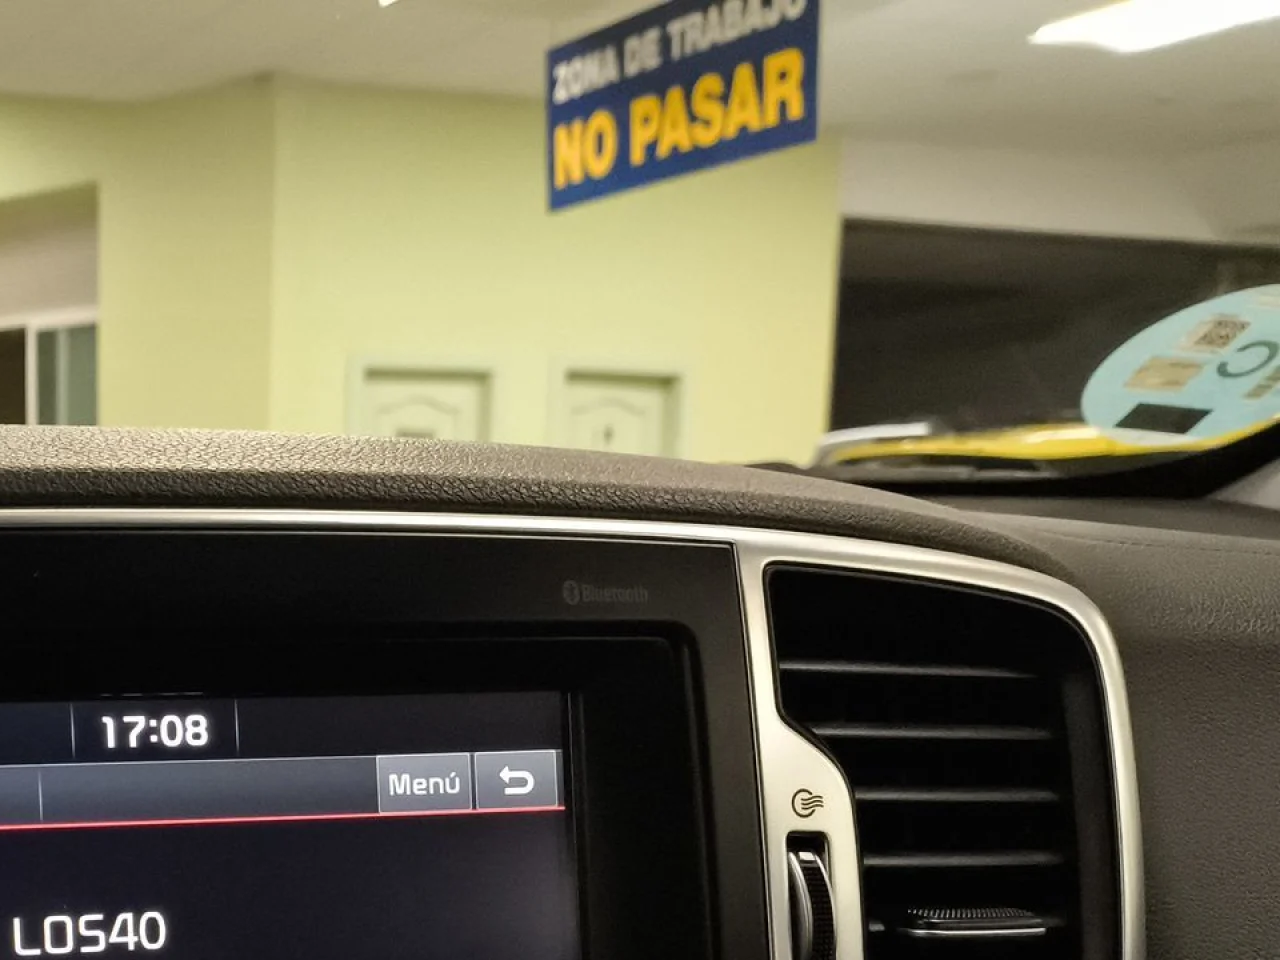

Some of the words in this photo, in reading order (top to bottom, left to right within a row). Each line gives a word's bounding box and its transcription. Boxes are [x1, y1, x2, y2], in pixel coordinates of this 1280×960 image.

[553, 45, 619, 105] ZONA
[623, 27, 663, 78] DE
[666, 0, 807, 61] TRABAJO
[553, 109, 618, 189] NO
[629, 47, 805, 168] PASAR
[582, 583, 649, 603] Bluetooth
[101, 714, 209, 749] 17:08
[388, 771, 461, 796] Menú
[12, 911, 168, 957] LOS40
